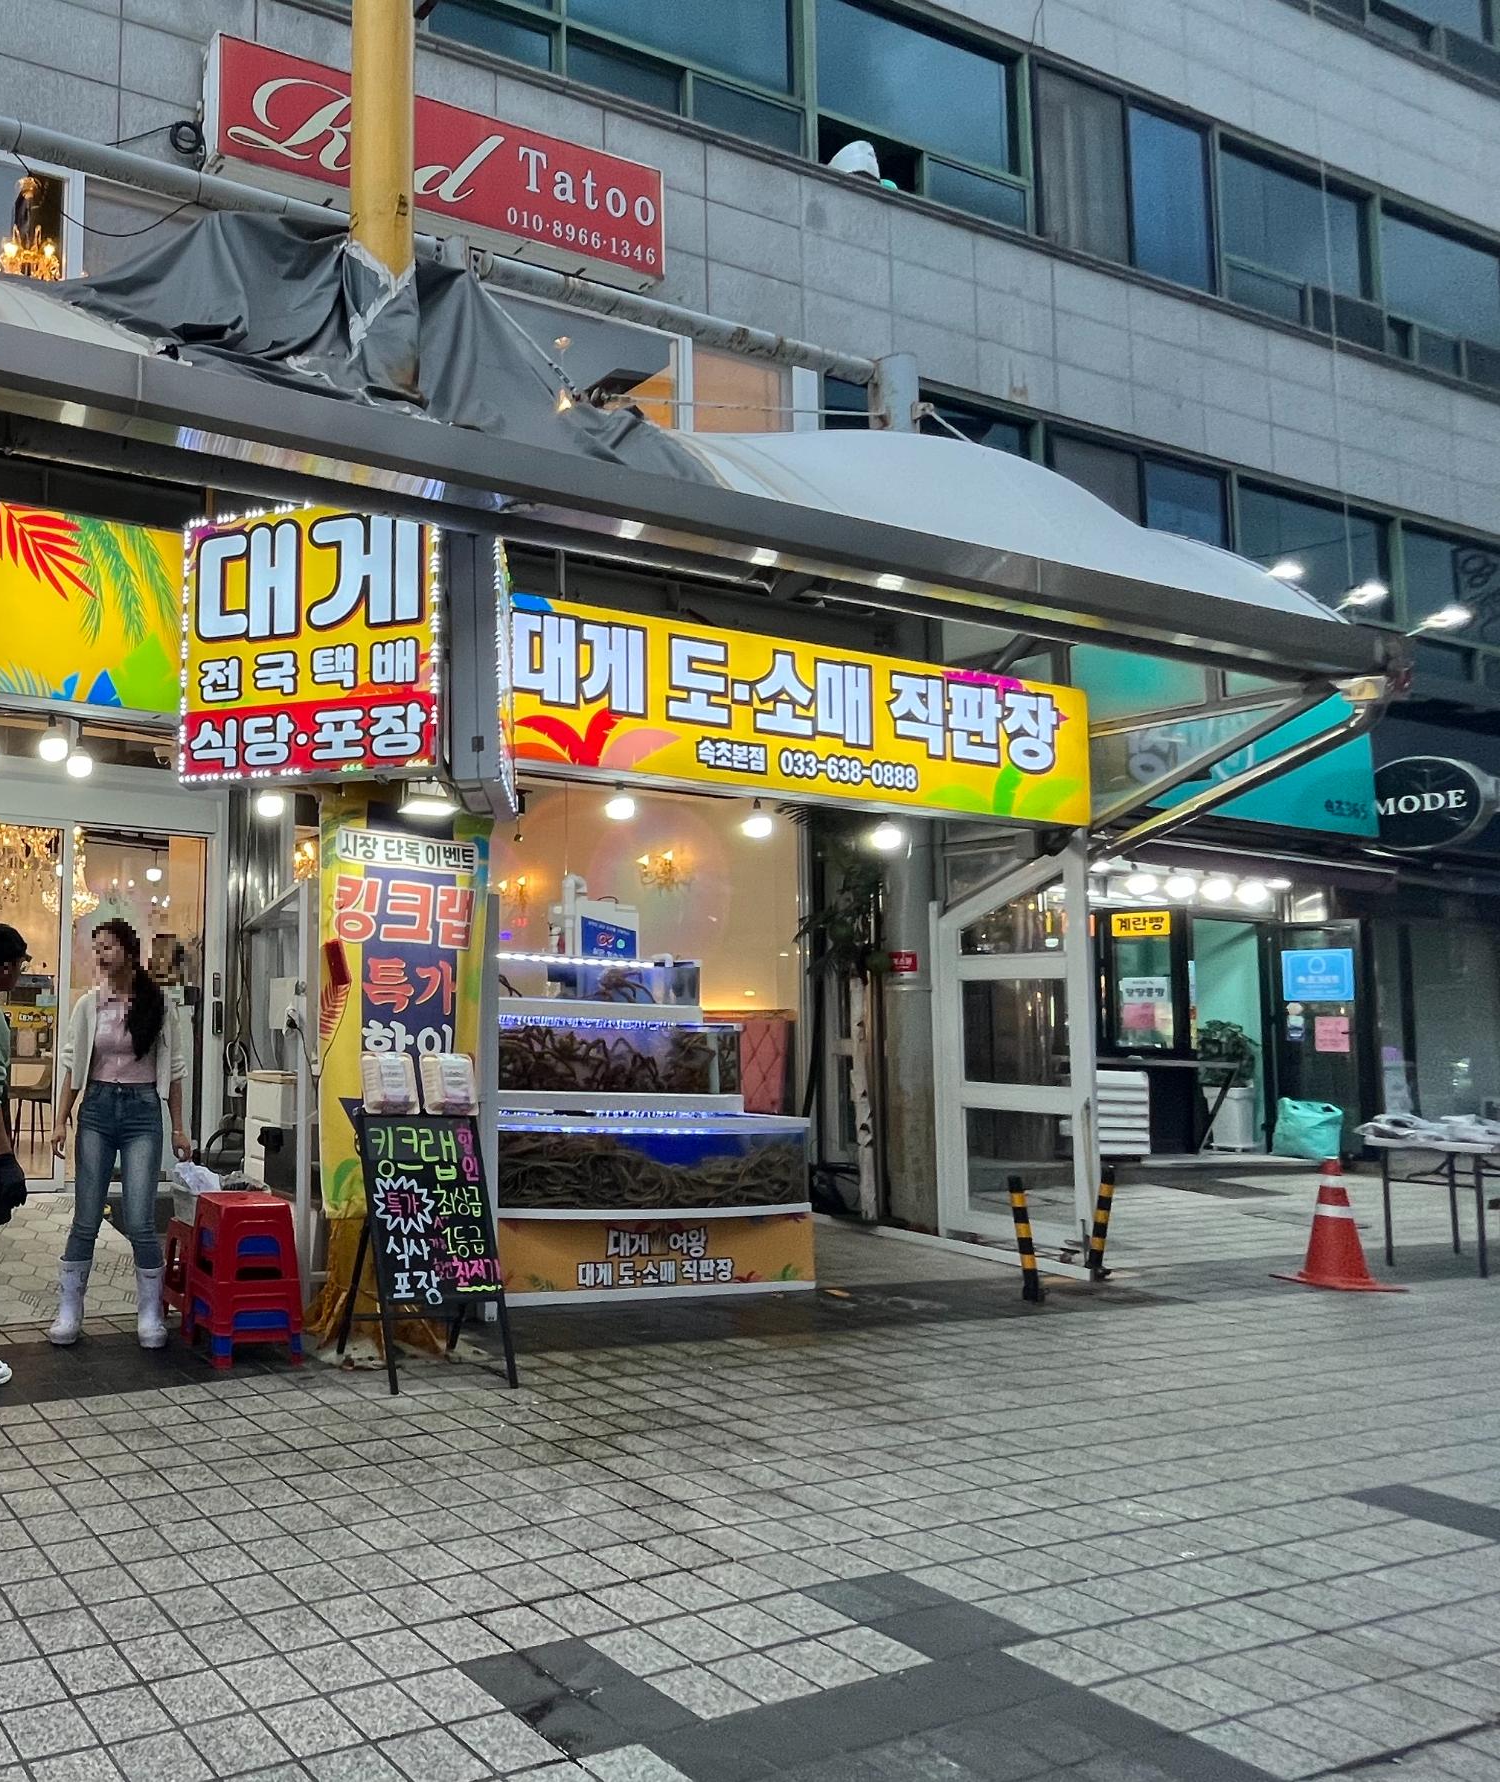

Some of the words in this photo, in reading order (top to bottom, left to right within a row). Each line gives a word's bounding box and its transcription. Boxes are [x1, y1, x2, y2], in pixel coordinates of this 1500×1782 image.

[226, 77, 505, 204] Rd
[518, 145, 656, 228] Tatoo
[196, 514, 426, 642] 대게
[511, 607, 647, 716] 대게
[889, 670, 1059, 774] 직판장
[695, 738, 767, 774] 속초본점
[779, 749, 919, 793] 033-638-0888
[340, 831, 379, 859] 시장
[383, 838, 421, 862] 단독
[425, 842, 475, 870] 이벤트
[333, 874, 475, 950] 킹크랩
[1116, 916, 1165, 932] 계란빵
[362, 956, 457, 1016] 특가
[368, 1126, 458, 1181] 킹크랩
[386, 1191, 420, 1218] 특가
[432, 1183, 482, 1218] 최상급
[386, 1235, 431, 1269] 식사
[441, 1225, 486, 1258] 1등급
[606, 1229, 650, 1258] 대게
[668, 1227, 707, 1258] 여왕
[393, 1269, 443, 1305] 포장
[577, 1262, 613, 1287] 대게
[680, 1257, 734, 1283] 직판장
